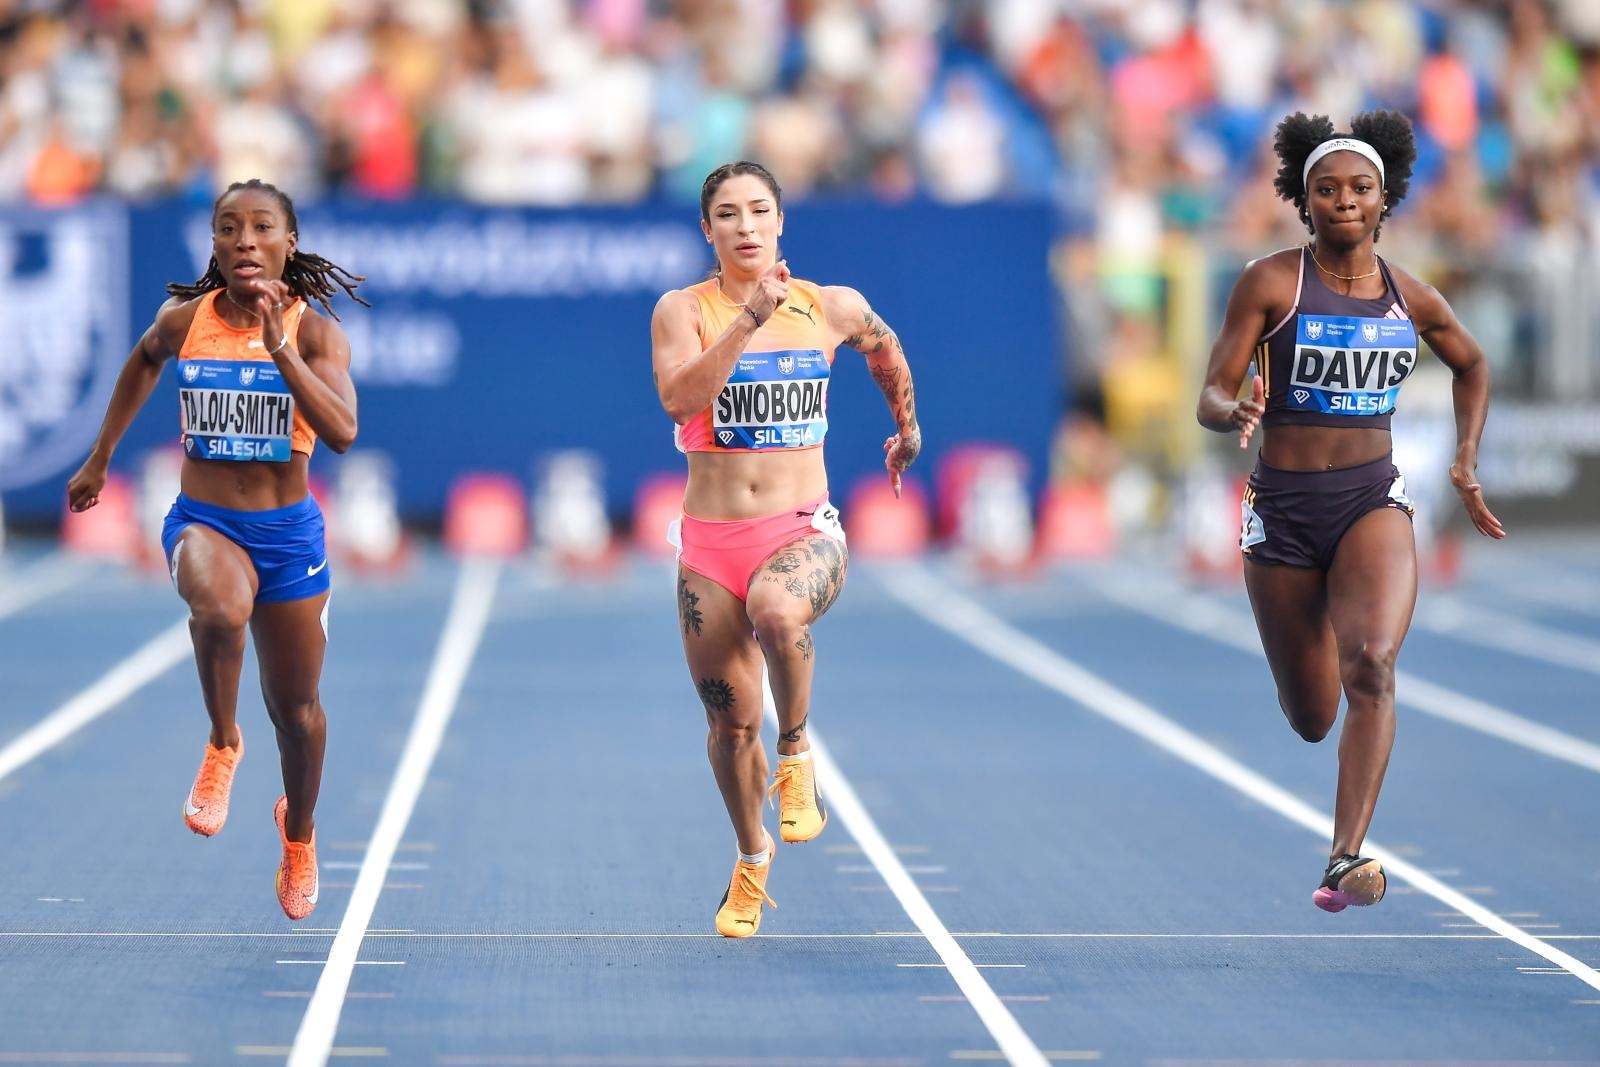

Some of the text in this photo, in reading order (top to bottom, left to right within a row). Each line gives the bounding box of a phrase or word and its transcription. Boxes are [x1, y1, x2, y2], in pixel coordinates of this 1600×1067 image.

[1295, 347, 1413, 390] DAVIS
[200, 392, 290, 436] LOU-SMITH
[717, 381, 824, 424] SWOBODA
[1329, 394, 1389, 412] SILESIA
[208, 439, 274, 457] SILESIA
[754, 427, 816, 445] SILESIA
